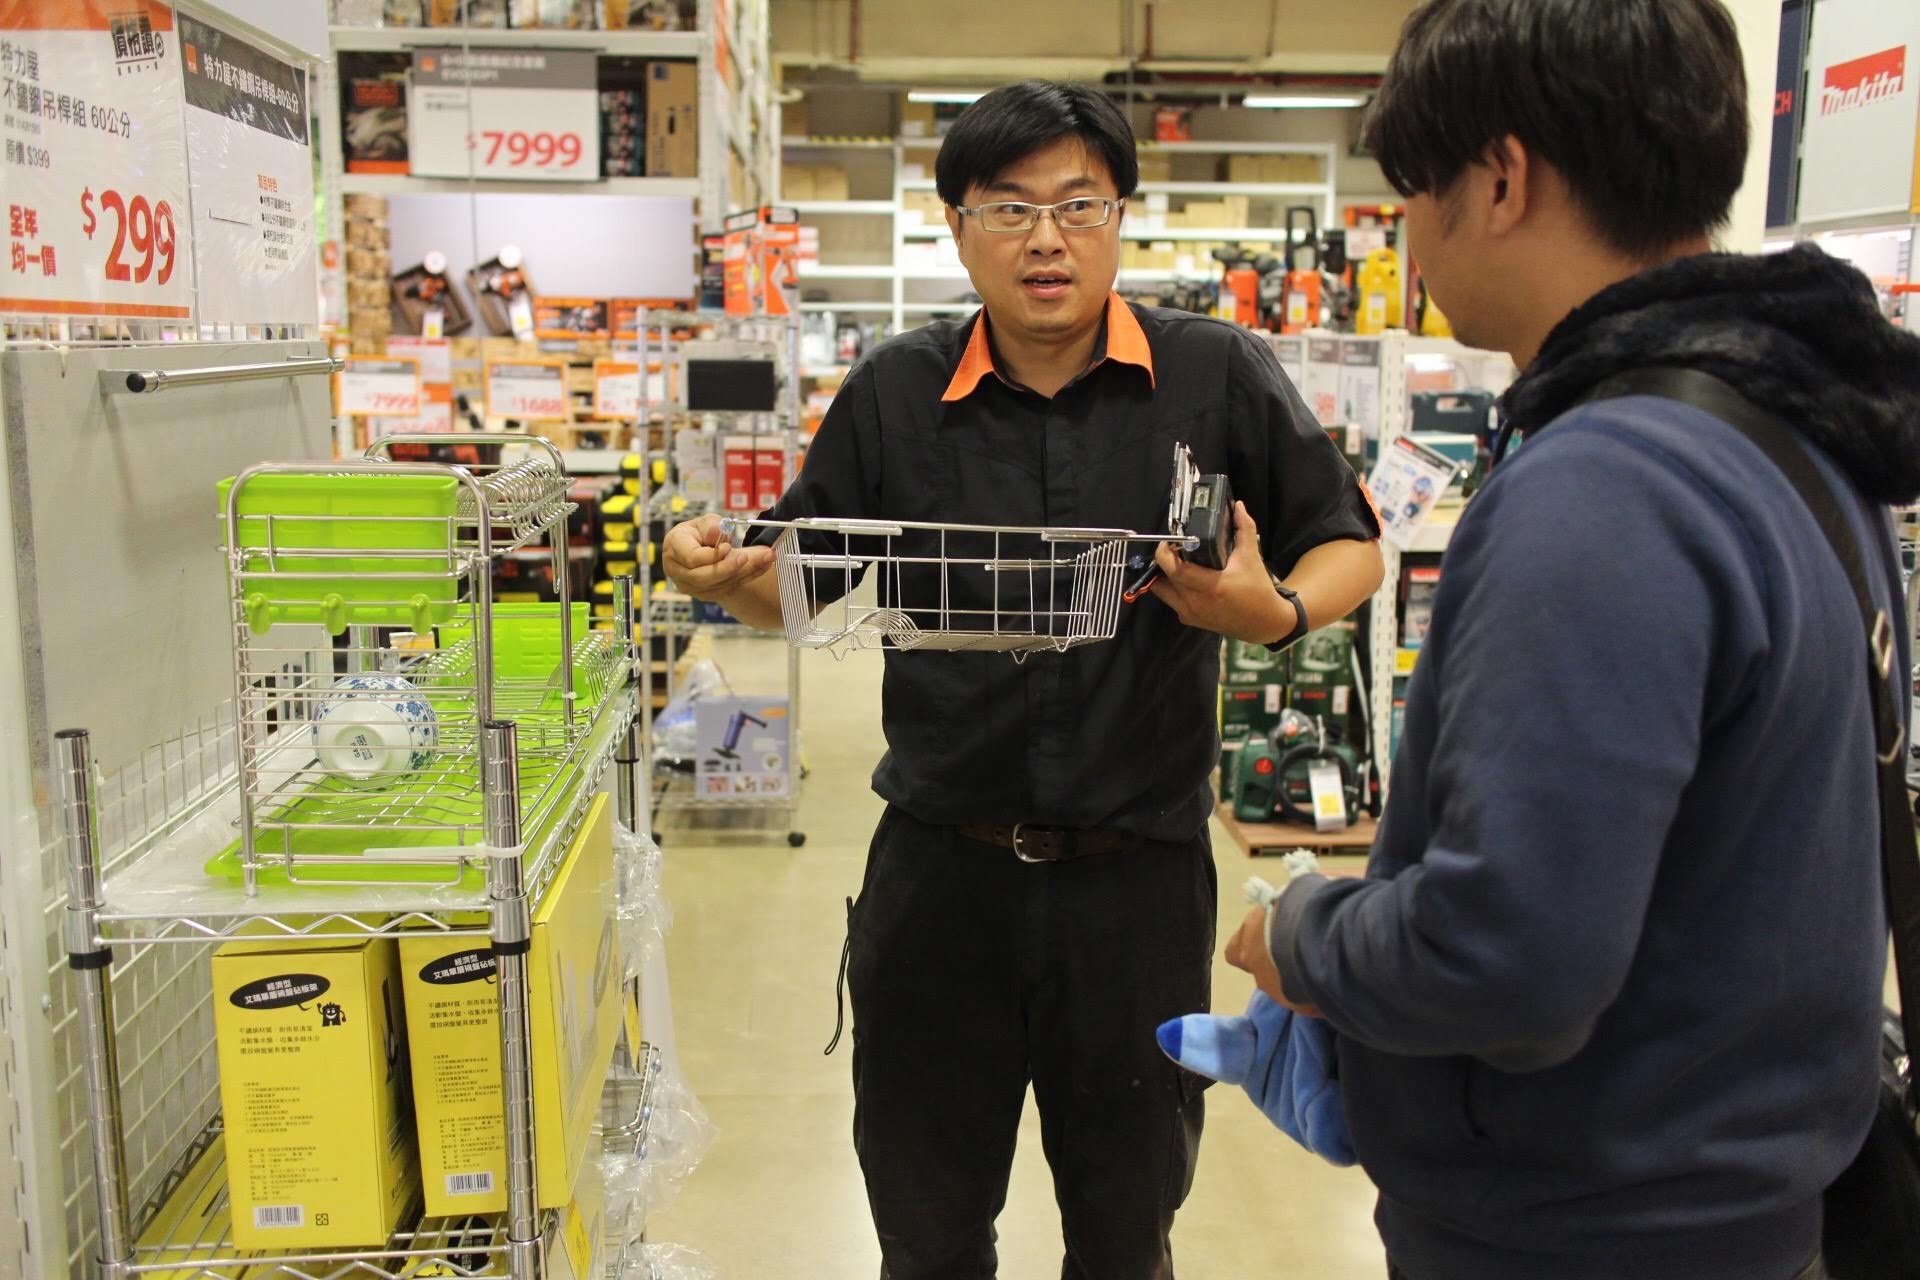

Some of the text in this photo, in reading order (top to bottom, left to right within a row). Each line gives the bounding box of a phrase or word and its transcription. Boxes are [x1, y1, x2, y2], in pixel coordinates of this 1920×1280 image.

[91, 105, 131, 139] 60公分
[27, 145, 50, 169] $399
[9, 203, 38, 239] 全年
[80, 186, 176, 286] $299
[11, 241, 57, 277] 均一價
